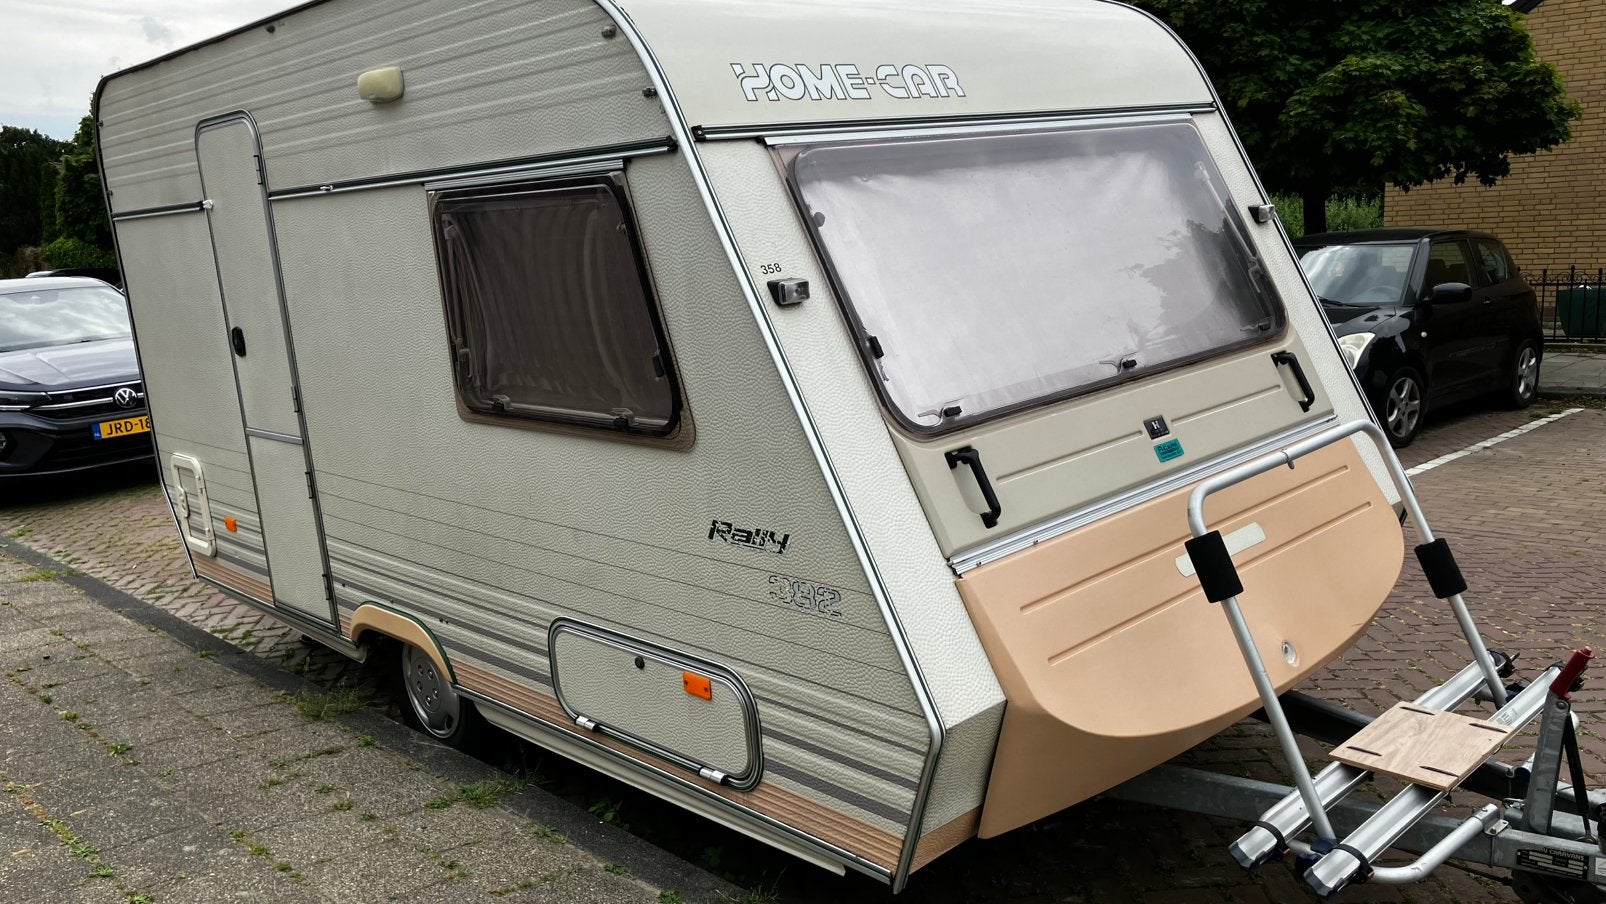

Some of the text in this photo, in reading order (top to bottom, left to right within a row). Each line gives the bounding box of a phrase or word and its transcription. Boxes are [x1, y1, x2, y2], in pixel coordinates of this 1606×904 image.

[730, 63, 966, 101] HOME-CAR
[760, 262, 782, 275] 358
[708, 519, 791, 555] Rally
[768, 575, 842, 617] 382
